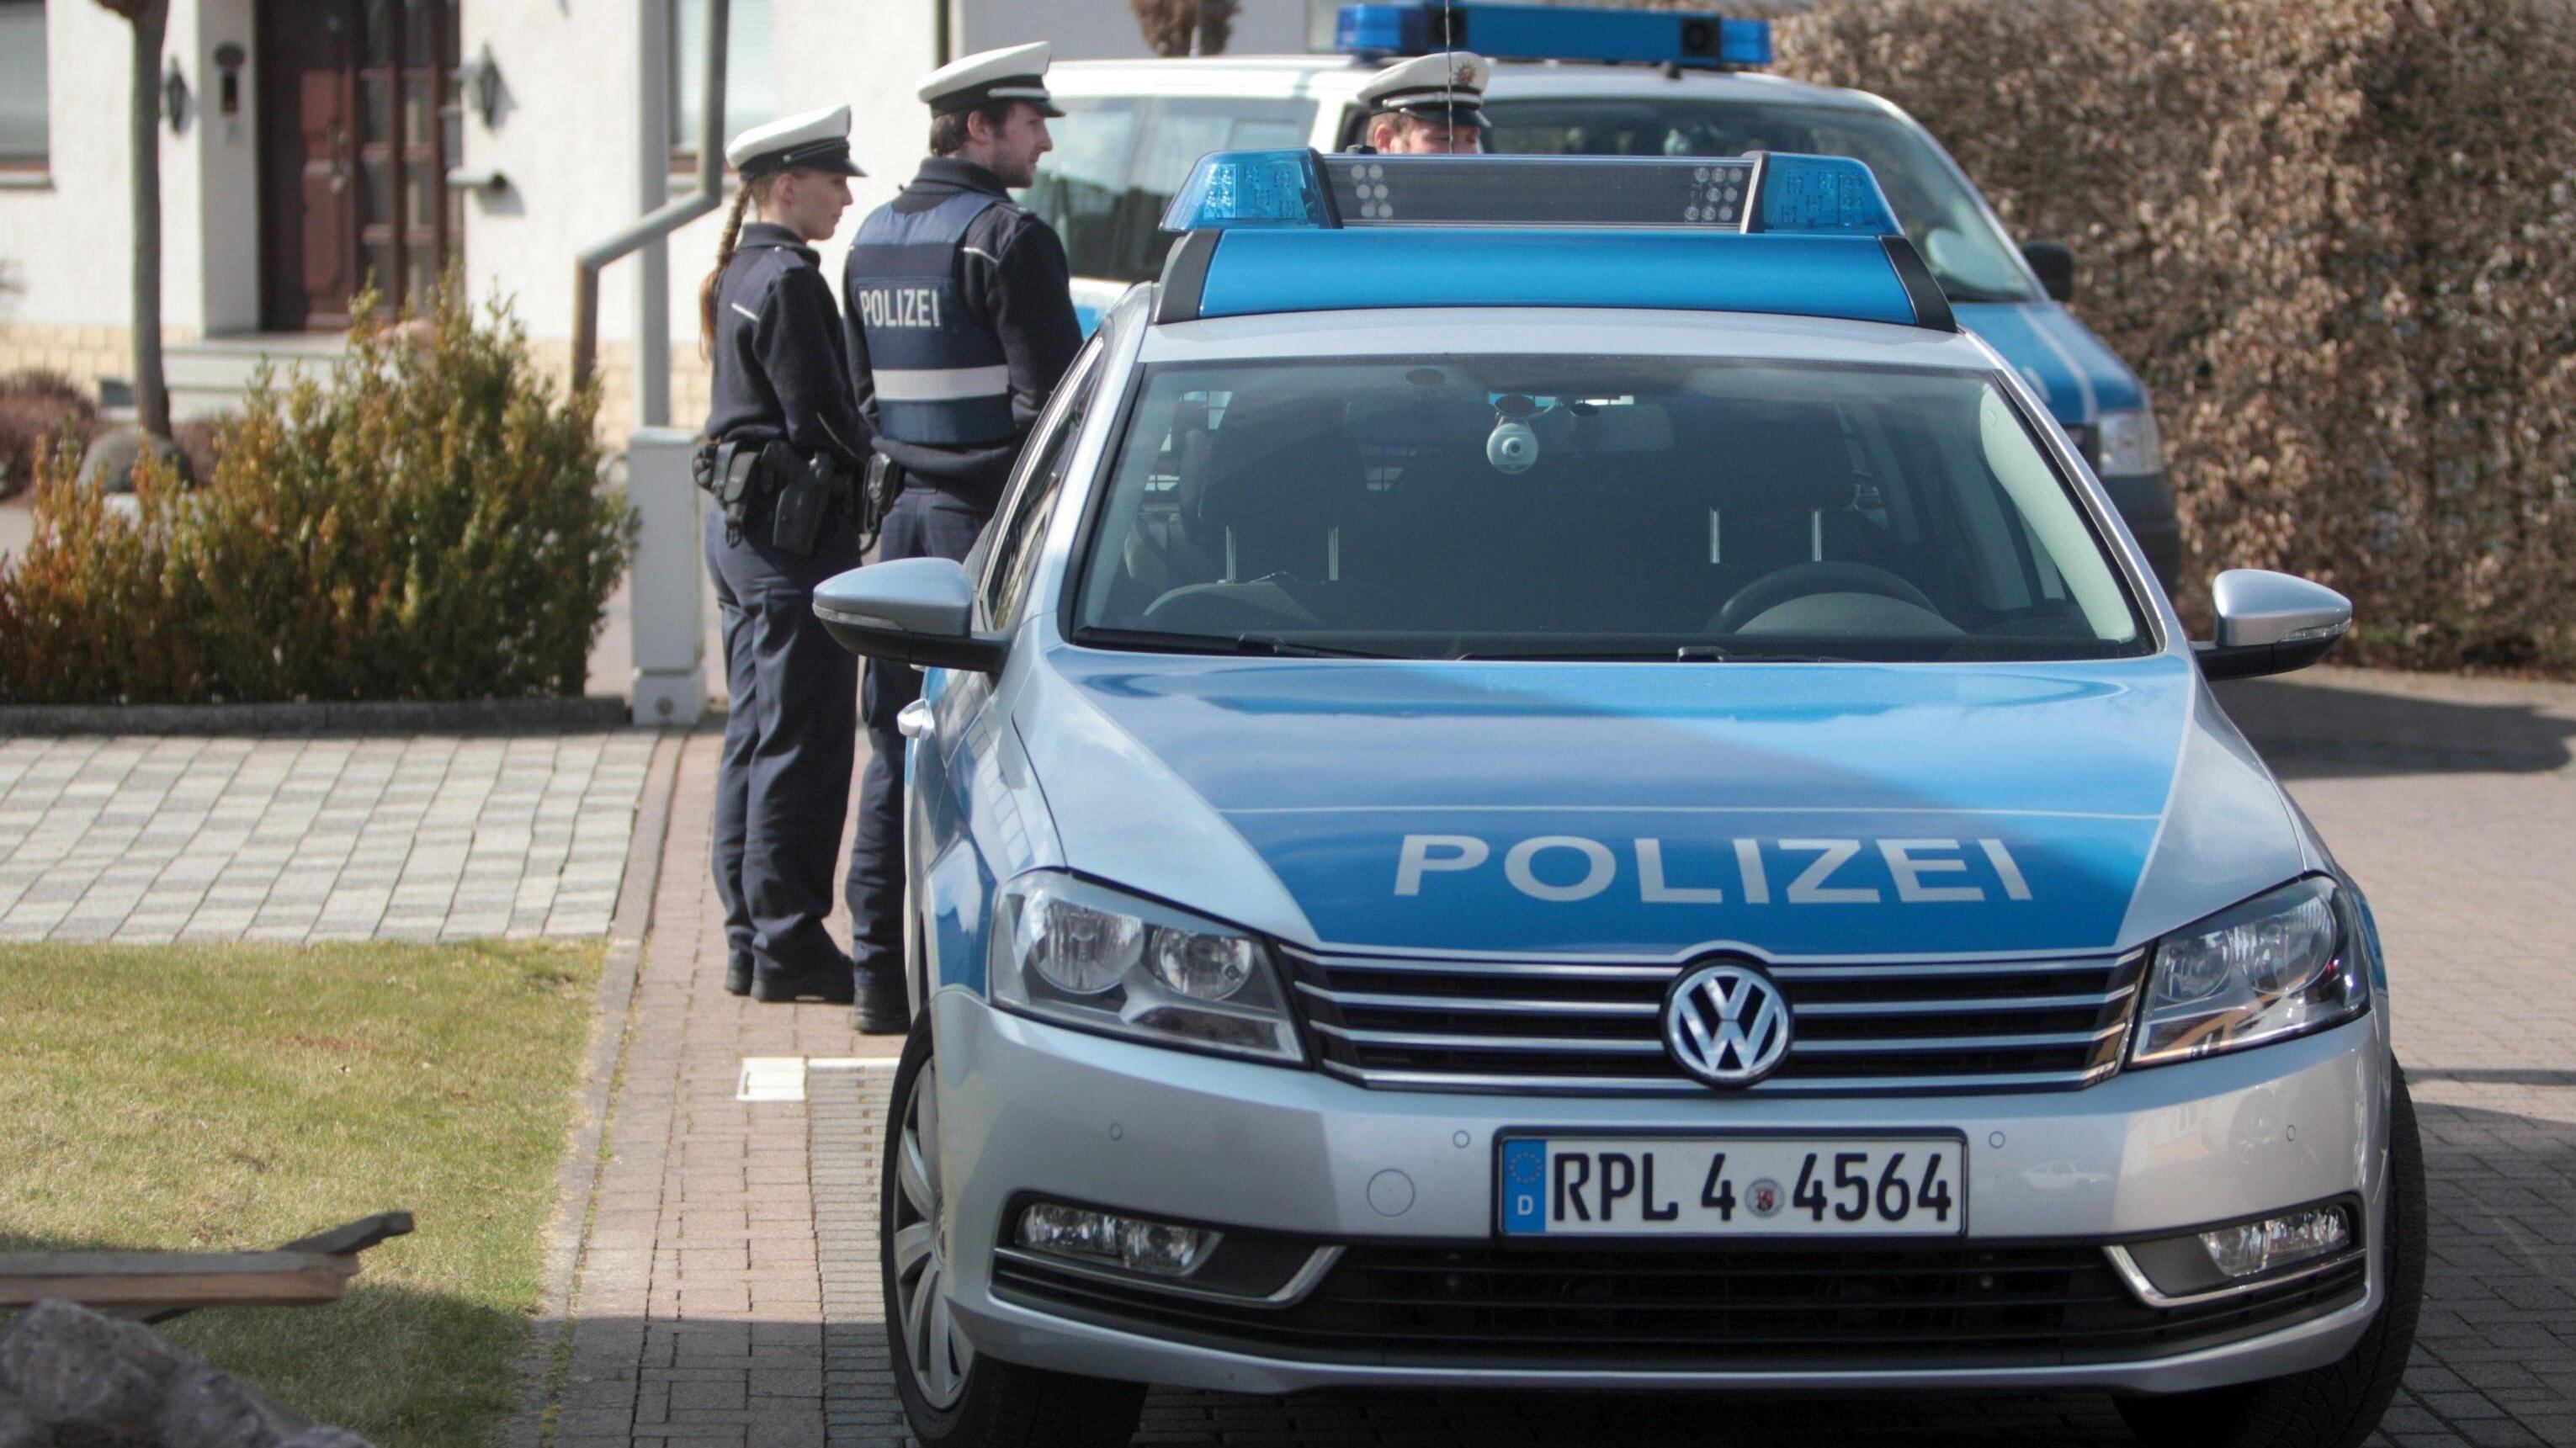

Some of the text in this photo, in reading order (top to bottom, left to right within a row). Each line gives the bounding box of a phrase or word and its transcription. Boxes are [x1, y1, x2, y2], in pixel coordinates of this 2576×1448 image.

[859, 289, 941, 328] POLIZEI
[1393, 834, 2033, 904] POLIZEI
[1517, 1195, 1533, 1216] D
[1554, 1153, 1952, 1223] RPL 4 4564
